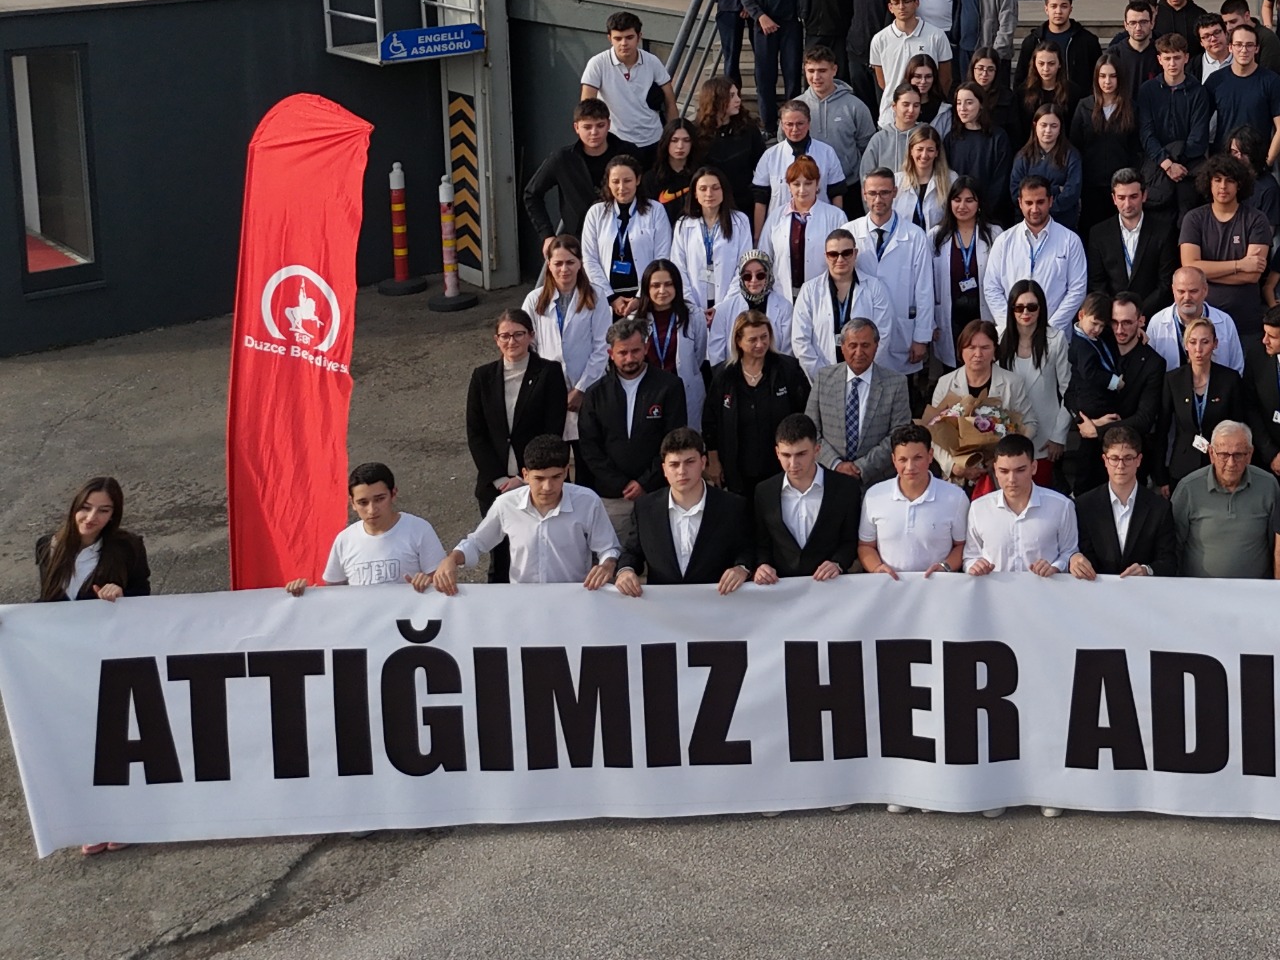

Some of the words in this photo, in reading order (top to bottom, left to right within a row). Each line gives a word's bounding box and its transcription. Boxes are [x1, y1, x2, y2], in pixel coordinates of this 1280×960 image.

[411, 40, 471, 55] ASANSÖRÜ
[418, 30, 464, 44] ENGELLİ
[354, 558, 401, 586] TED
[93, 619, 752, 787] ATTIĞIMIZ
[785, 638, 1021, 766] HER
